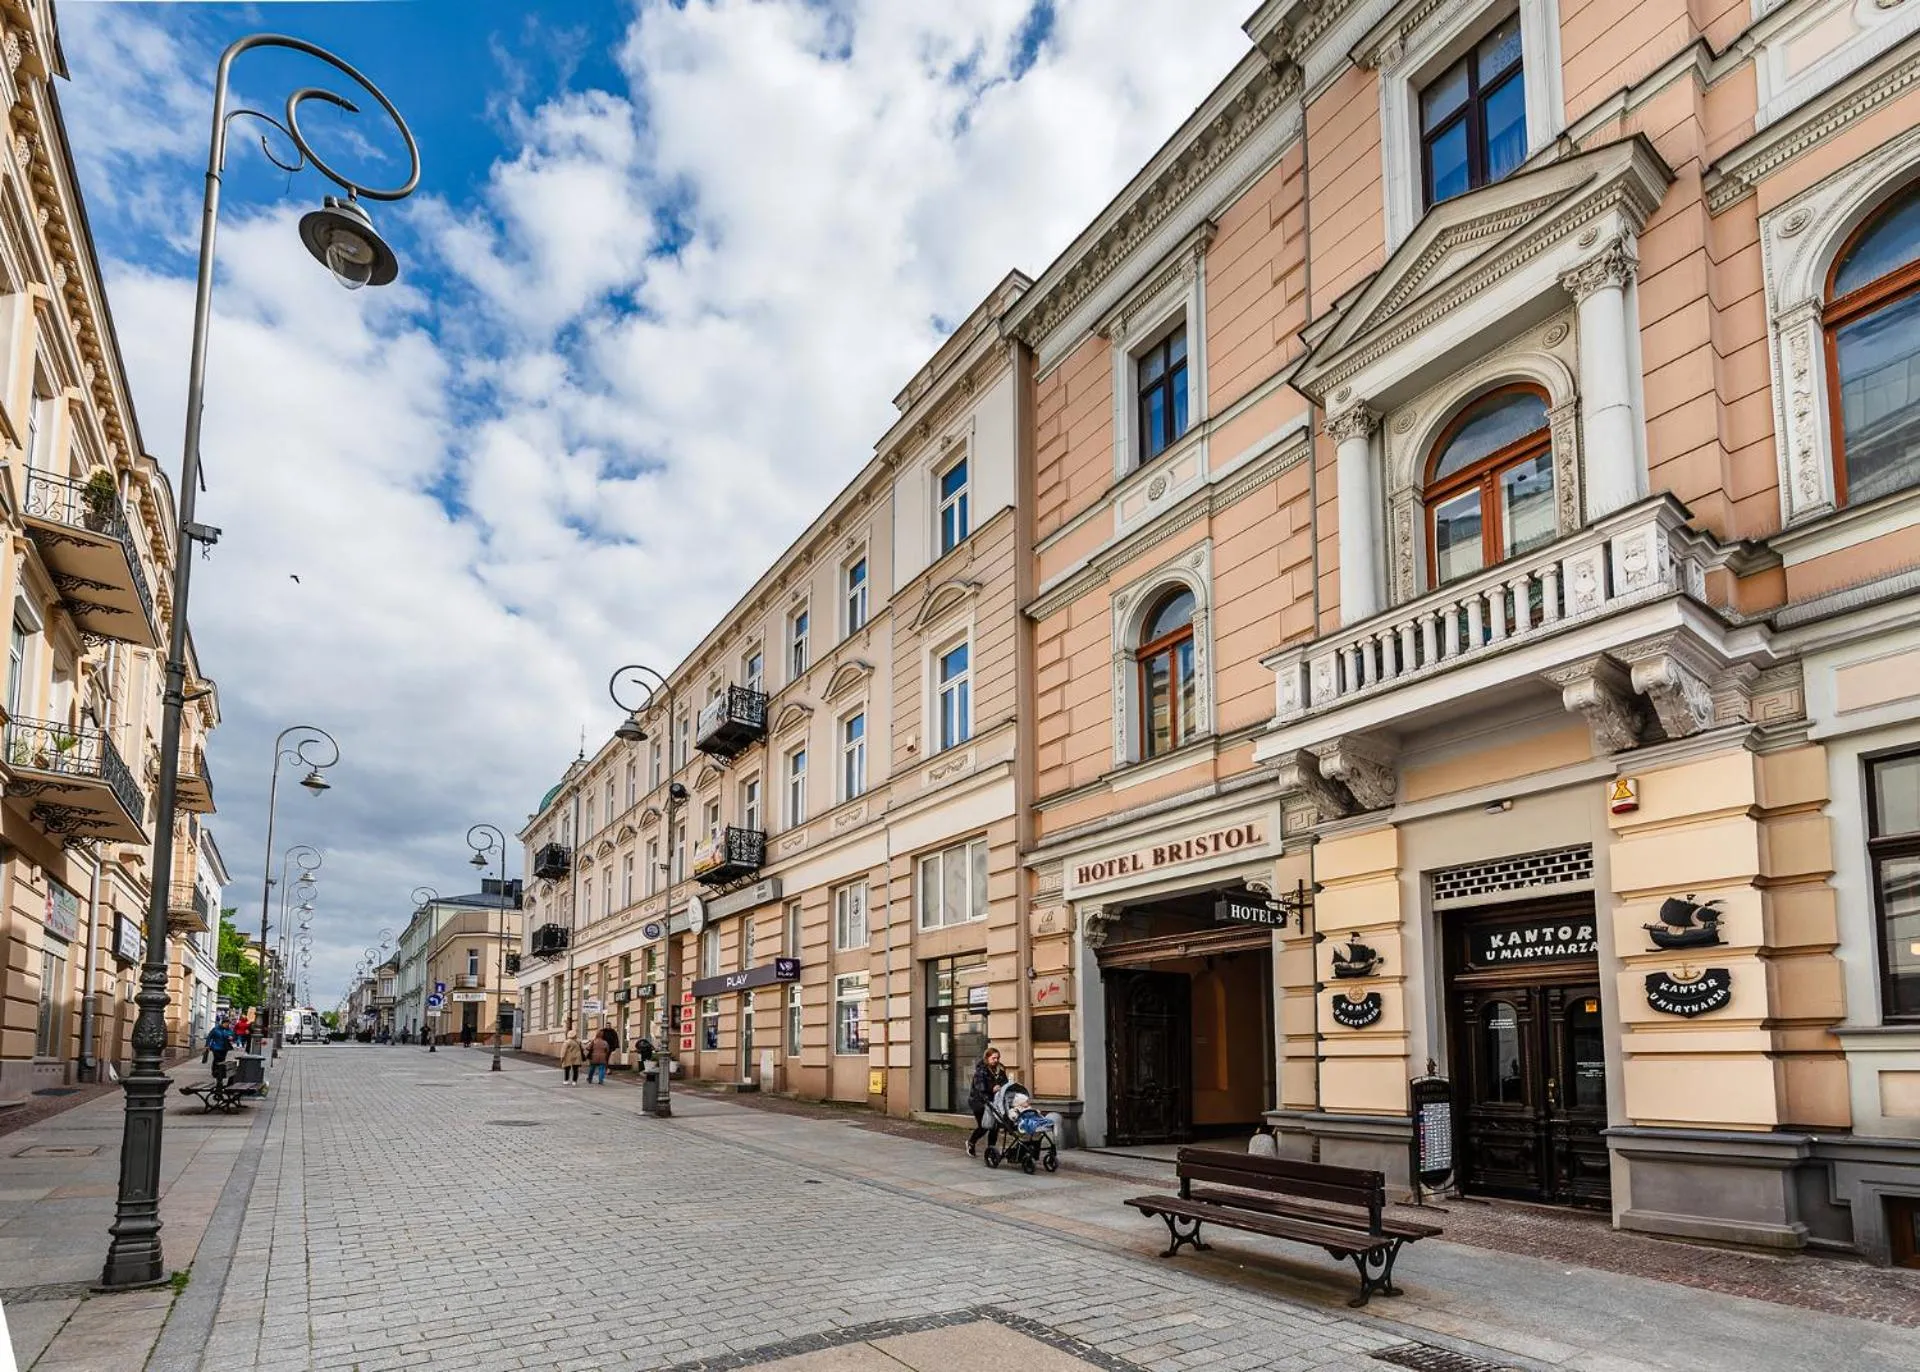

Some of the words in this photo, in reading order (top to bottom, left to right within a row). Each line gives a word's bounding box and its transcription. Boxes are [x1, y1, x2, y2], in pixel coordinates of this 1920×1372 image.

[1078, 854, 1144, 884] HOTEL
[1152, 824, 1261, 866] BRISTOL
[1230, 904, 1275, 924] HOTEL
[1490, 925, 1593, 949] KANTOR
[1485, 950, 1496, 961] U
[1500, 941, 1599, 960] MARYNARZA
[726, 974, 748, 988] PLAY
[1659, 978, 1719, 994] KANTOR
[1649, 992, 1659, 1000] U
[1657, 989, 1727, 1013] MARYNARZA
